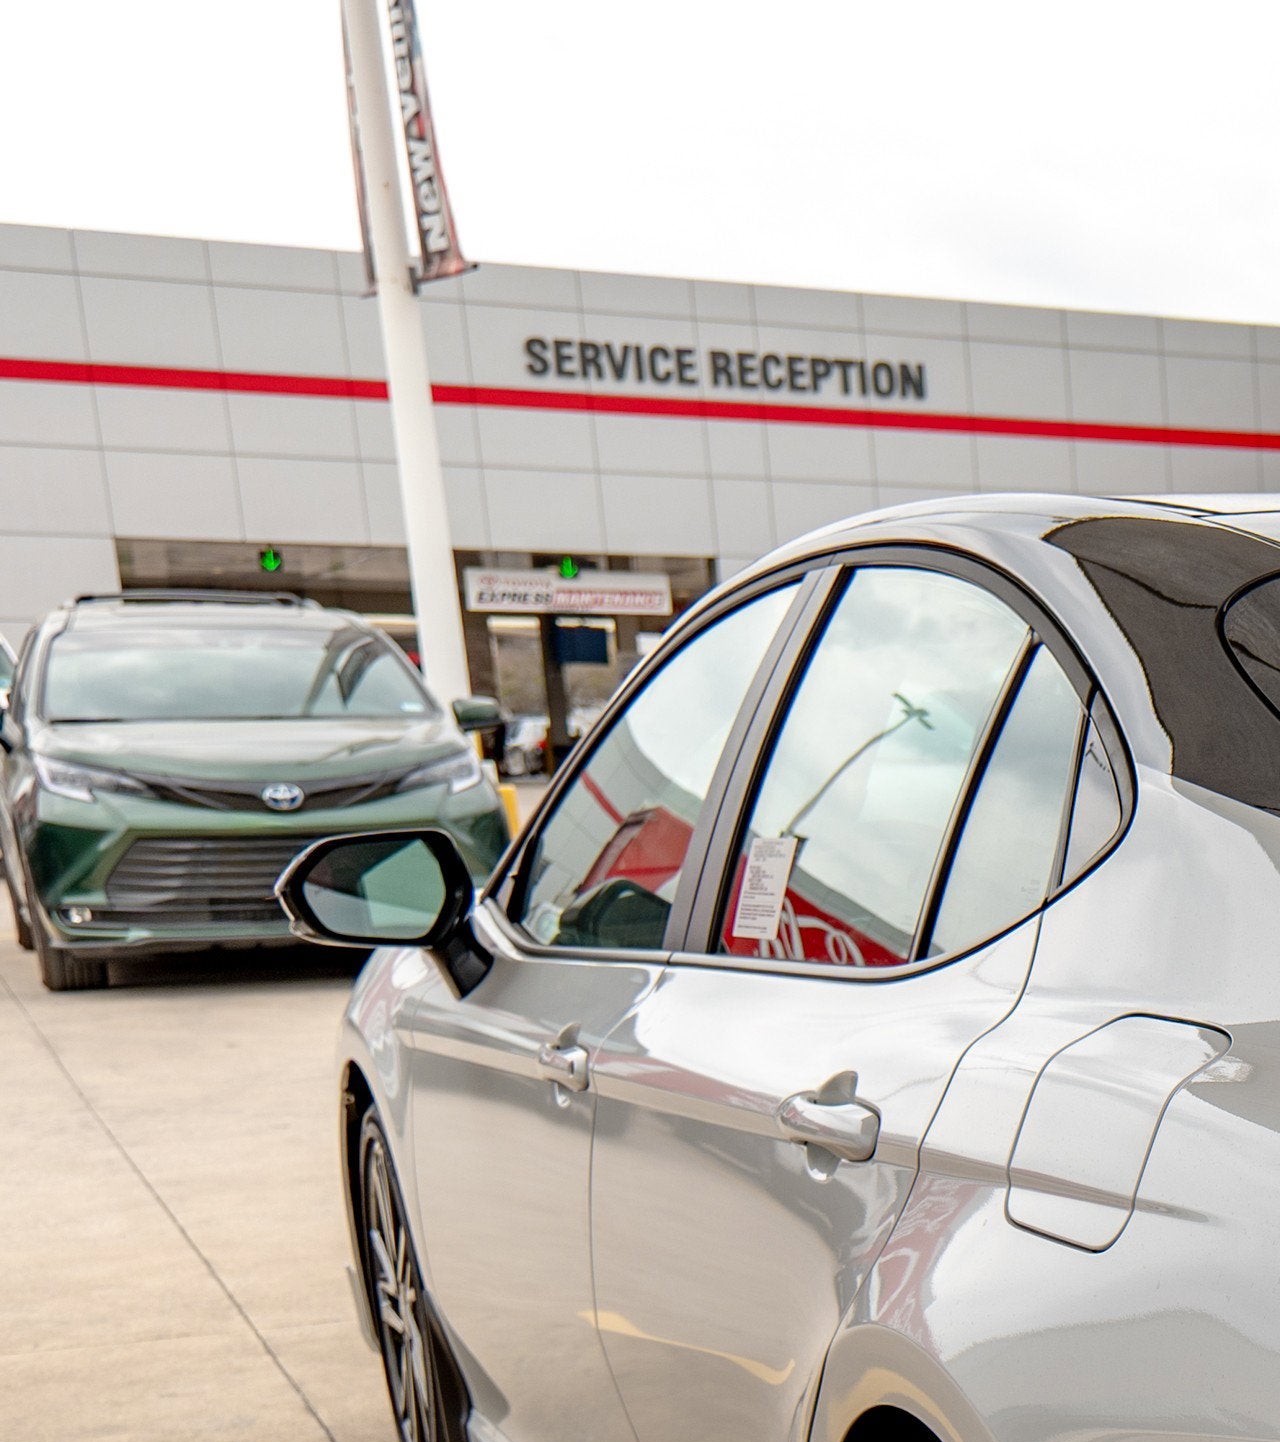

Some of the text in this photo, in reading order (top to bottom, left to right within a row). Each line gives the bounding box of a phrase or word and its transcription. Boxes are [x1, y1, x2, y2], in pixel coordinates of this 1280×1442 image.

[408, 138, 450, 252] New
[524, 336, 928, 400] SERVICE RECEPTION
[477, 590, 554, 605] EXPRESS
